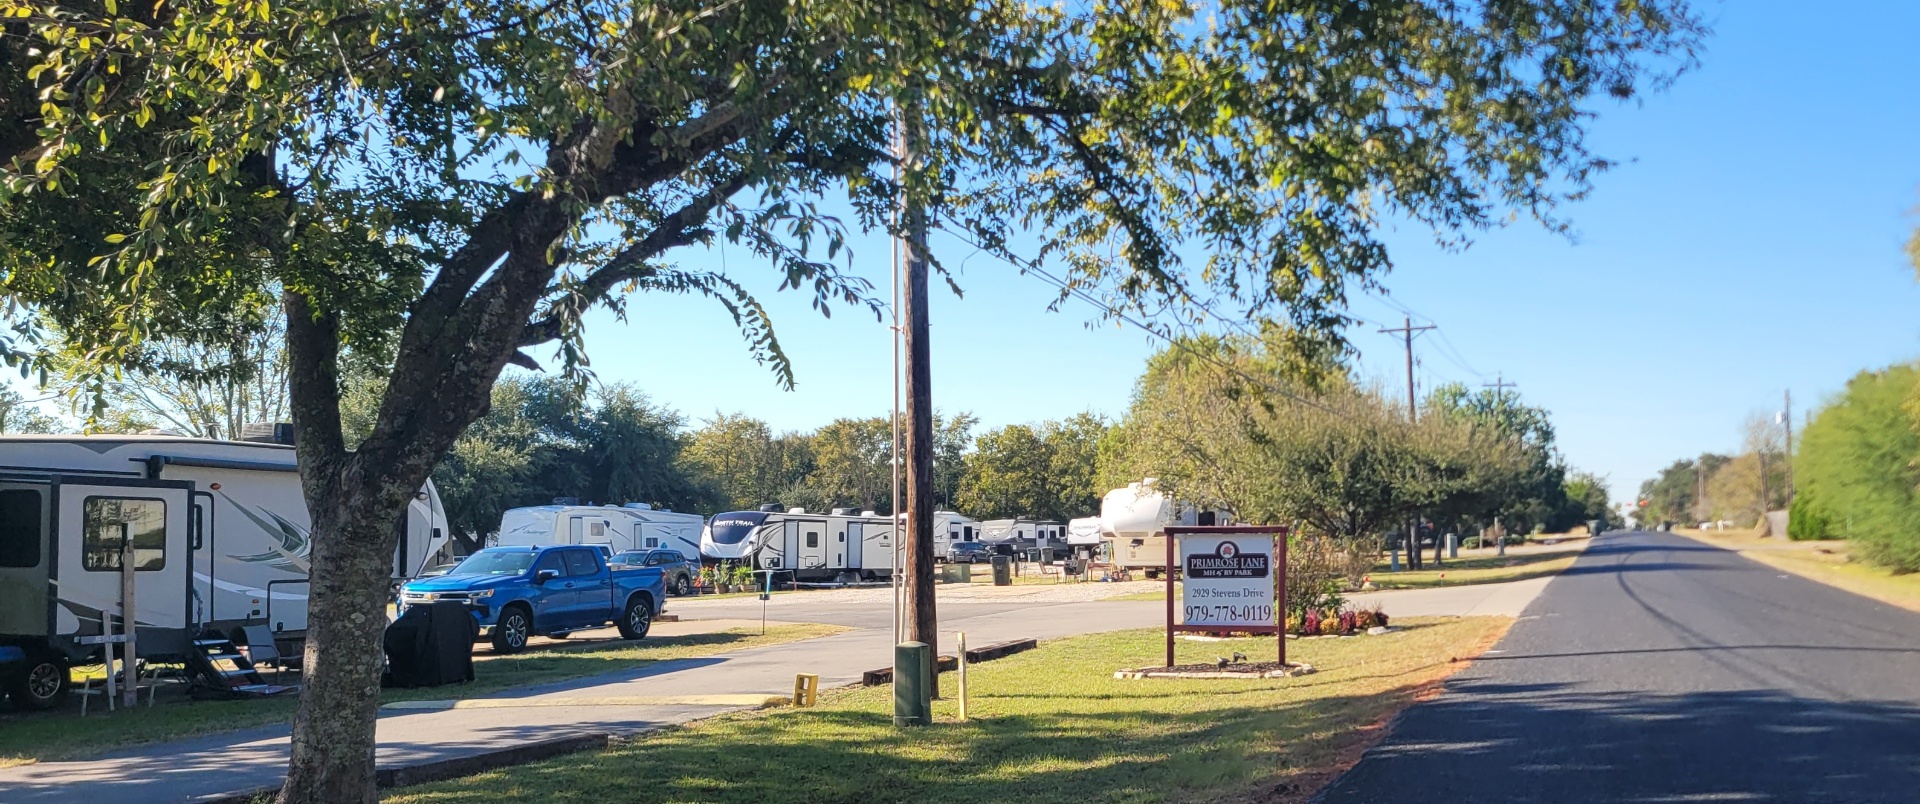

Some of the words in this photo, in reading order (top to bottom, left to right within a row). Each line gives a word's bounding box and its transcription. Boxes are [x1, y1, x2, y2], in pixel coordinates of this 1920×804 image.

[1191, 558, 1238, 569] PRIMROSE
[1241, 557, 1265, 569] LANE
[1192, 588, 1210, 598] 2929
[1211, 588, 1241, 598] Stevens
[1243, 588, 1265, 598] Drive
[1186, 605, 1271, 621] 979-778-0119
